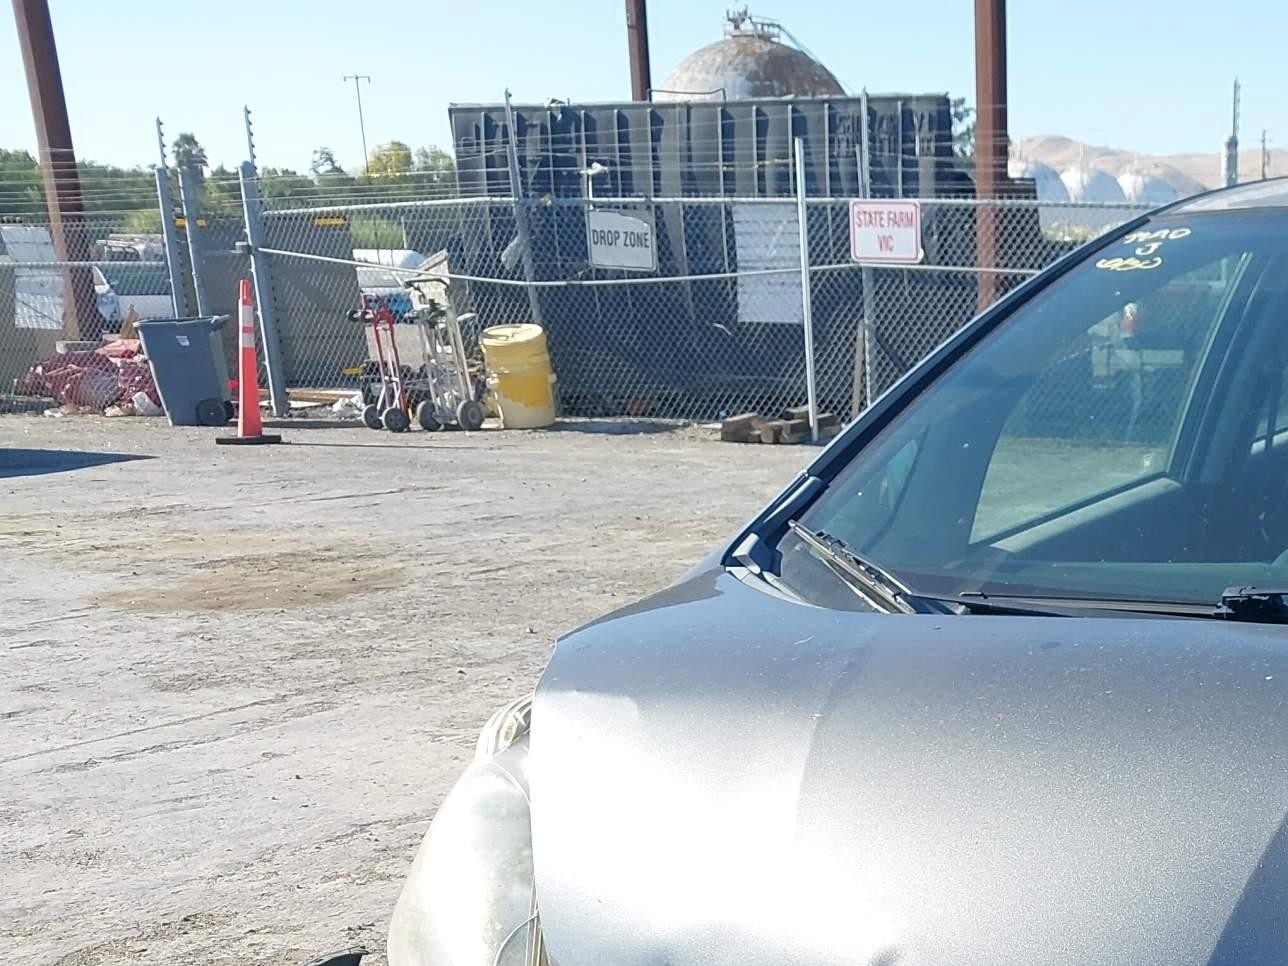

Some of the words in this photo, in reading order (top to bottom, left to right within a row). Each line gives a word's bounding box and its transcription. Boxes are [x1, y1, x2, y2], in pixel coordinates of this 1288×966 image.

[856, 210, 884, 228] STATE
[887, 210, 914, 228] FARM
[592, 228, 620, 247] DROP
[622, 231, 650, 249] ZONE
[877, 234, 894, 252] VIC
